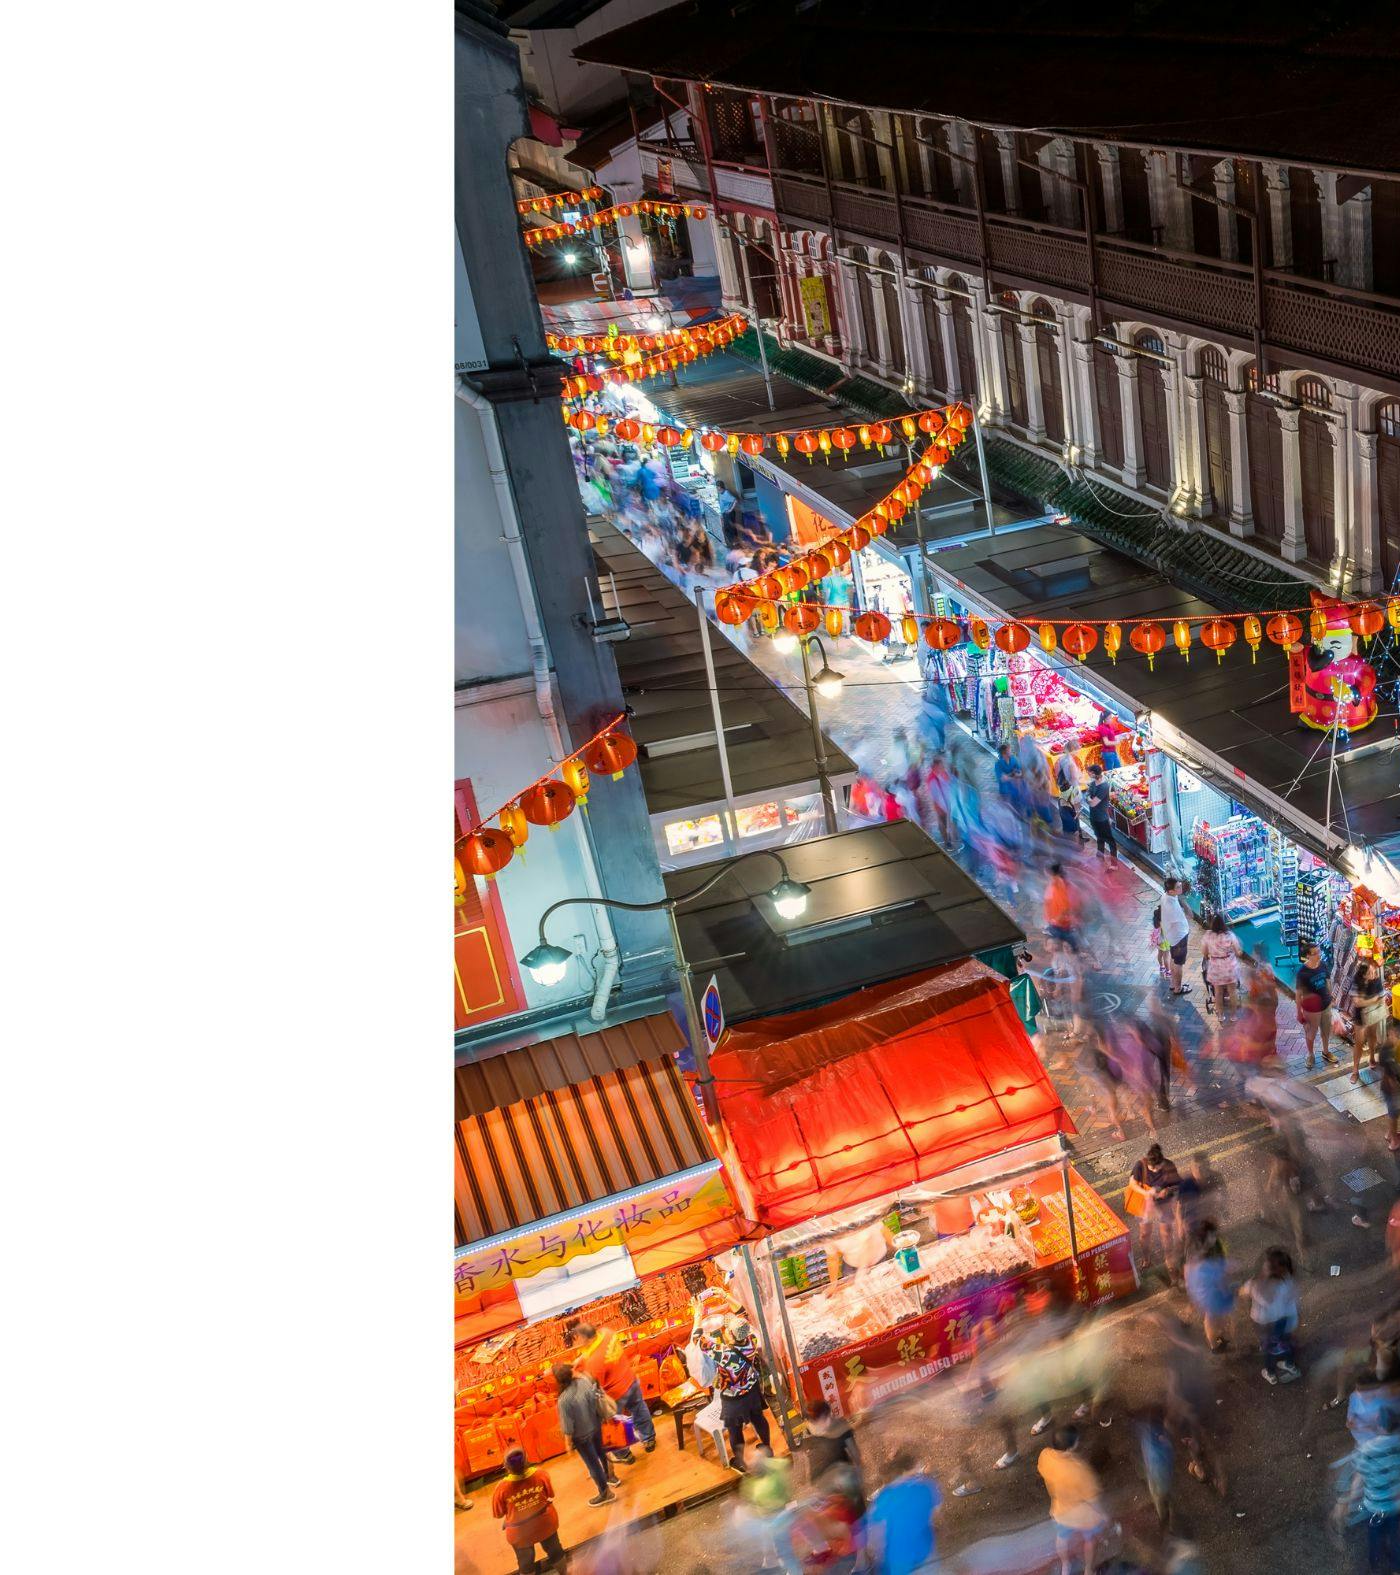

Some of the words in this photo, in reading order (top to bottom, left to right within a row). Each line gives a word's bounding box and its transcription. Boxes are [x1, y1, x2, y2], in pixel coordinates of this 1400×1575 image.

[455, 1190, 692, 1294] 香水与化妆品
[872, 1369, 919, 1400] NATURAL
